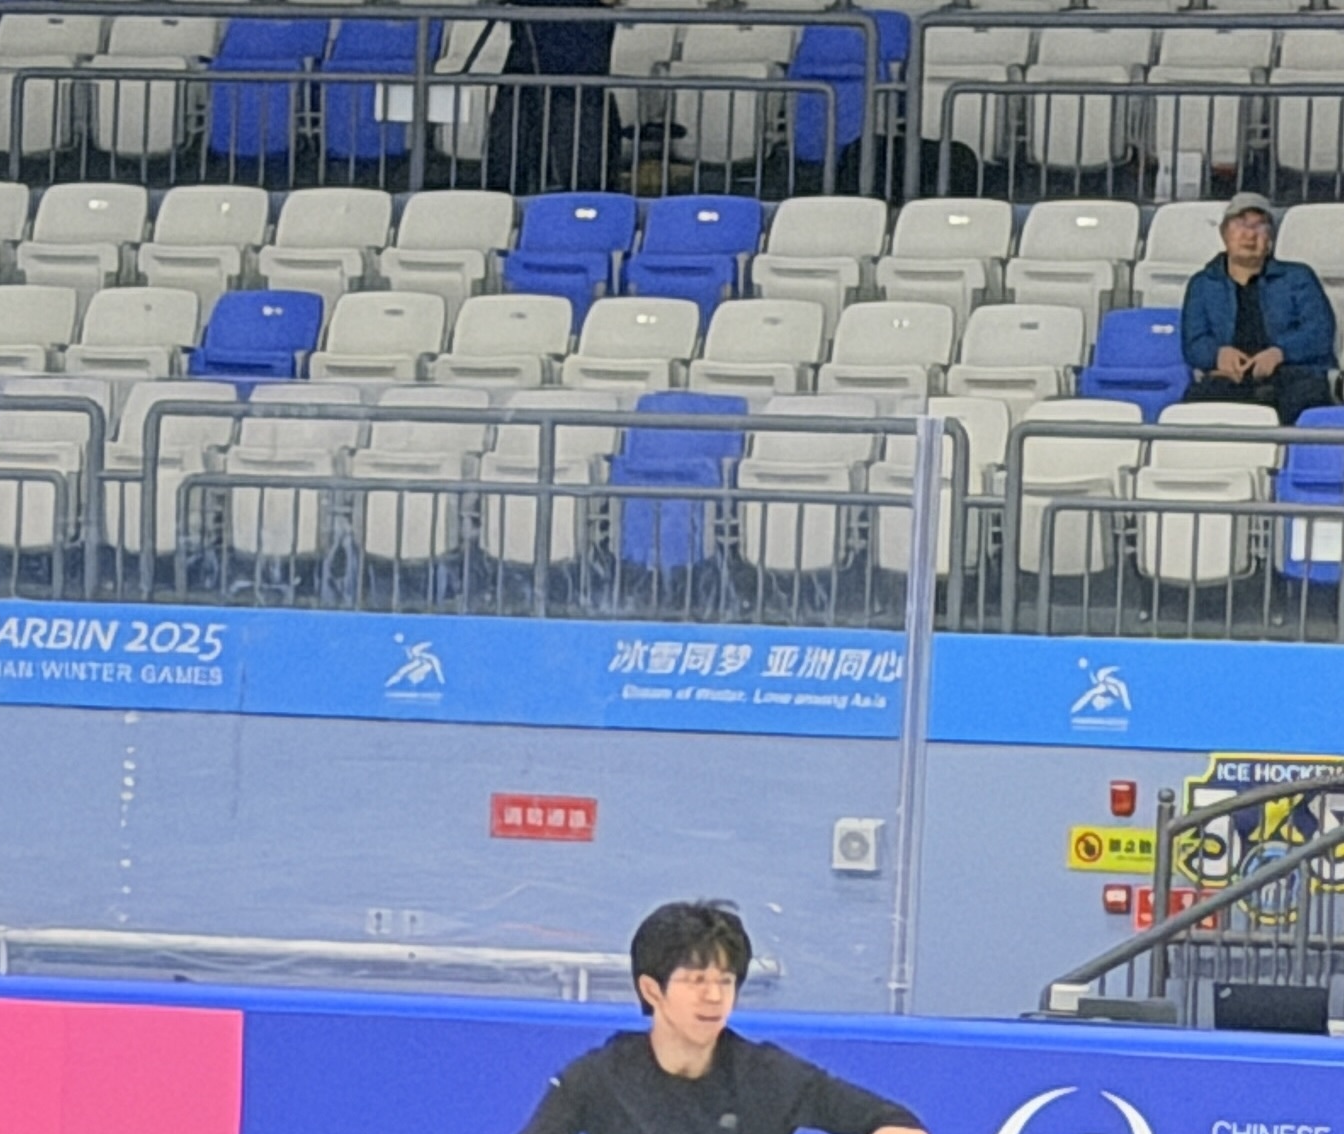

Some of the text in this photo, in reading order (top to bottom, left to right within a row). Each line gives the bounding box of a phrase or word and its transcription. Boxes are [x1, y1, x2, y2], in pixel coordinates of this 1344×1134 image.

[124, 621, 228, 662] 2025
[41, 660, 133, 683] WINTER
[140, 664, 224, 686] GAMES
[608, 639, 904, 682] 冰雪同梦 亚洲同心
[1217, 763, 1251, 782] ICE
